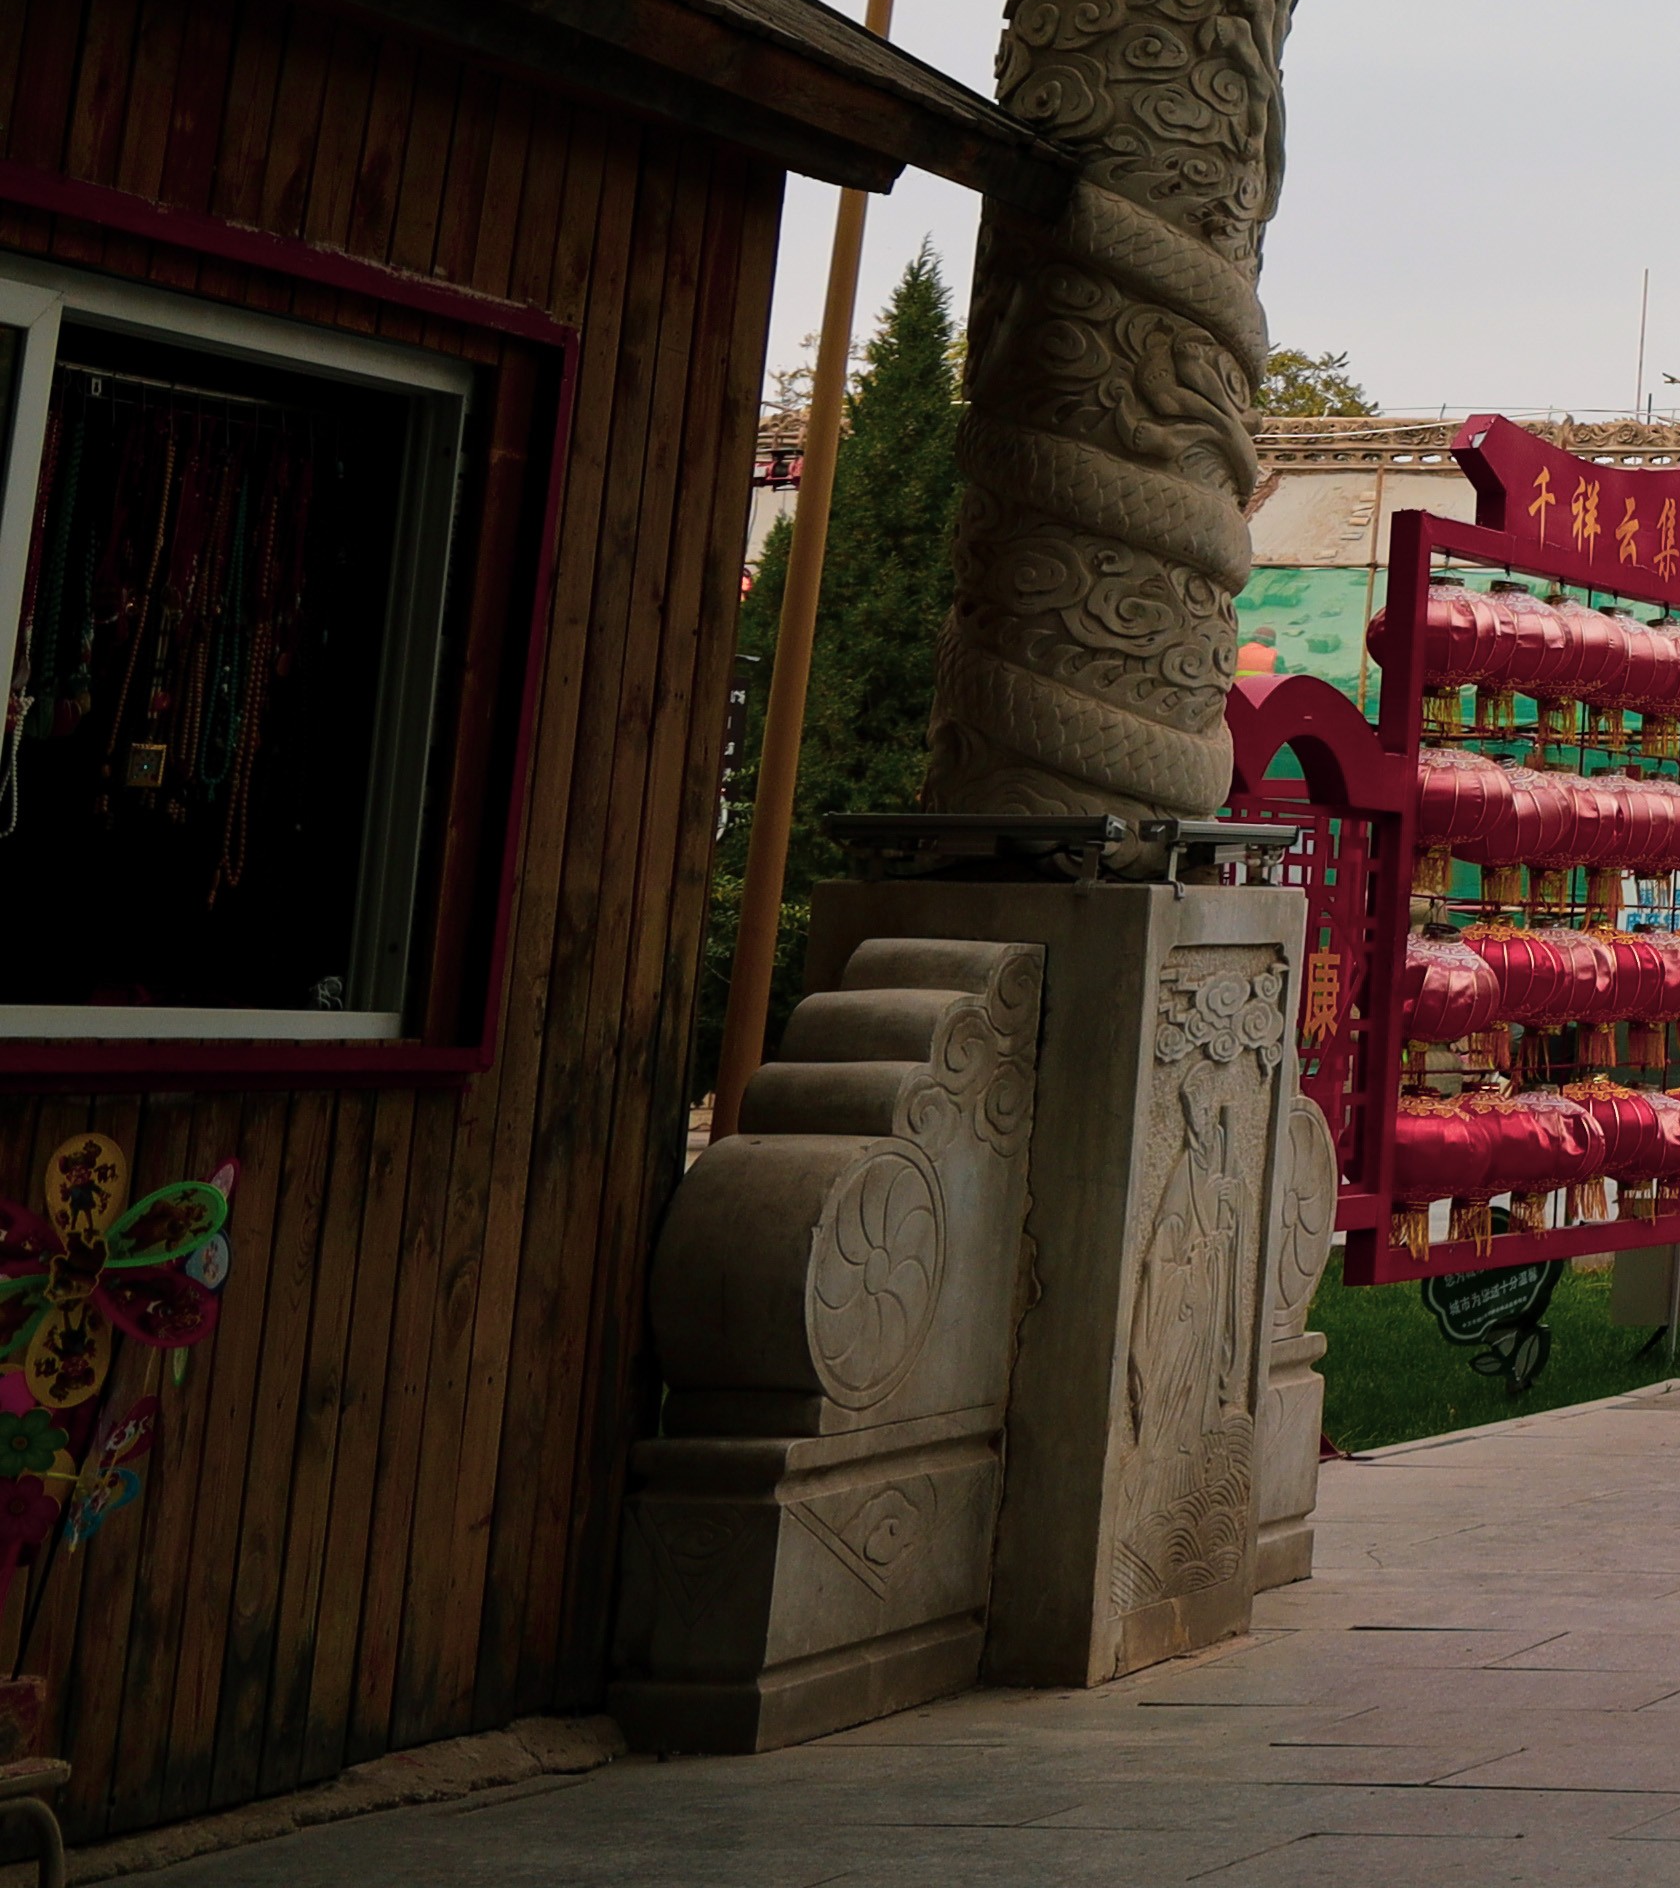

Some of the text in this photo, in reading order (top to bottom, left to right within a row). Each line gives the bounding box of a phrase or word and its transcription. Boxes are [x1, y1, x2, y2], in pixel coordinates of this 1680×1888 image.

[1528, 466, 1680, 583] 千祥云集
[1303, 946, 1341, 1043] 康
